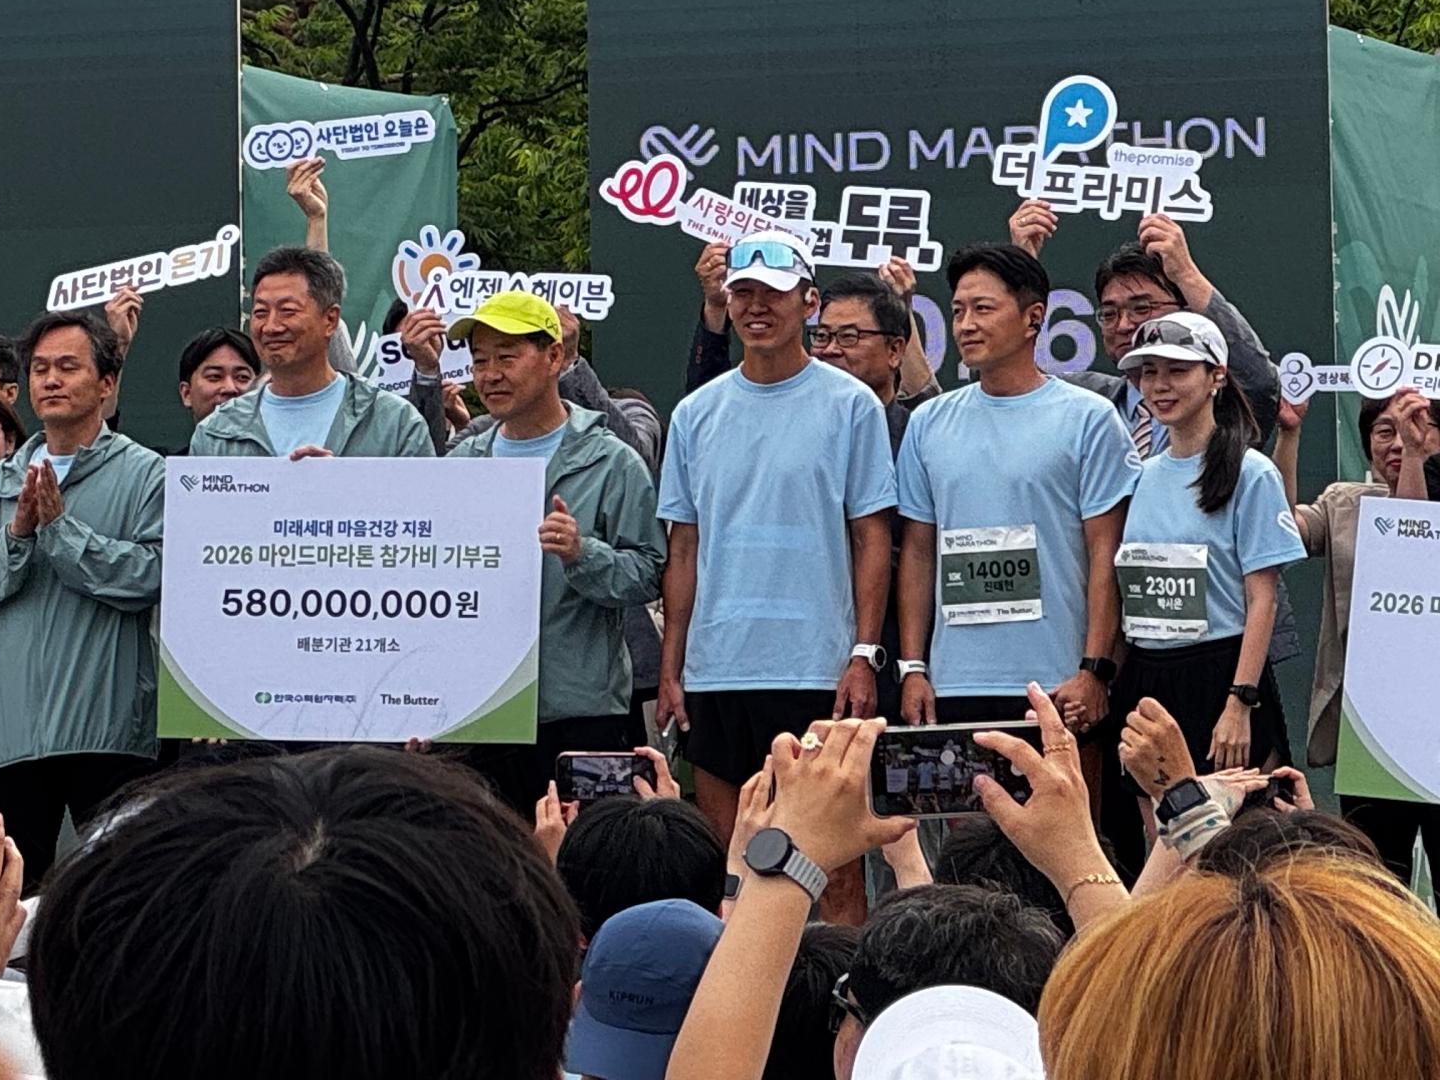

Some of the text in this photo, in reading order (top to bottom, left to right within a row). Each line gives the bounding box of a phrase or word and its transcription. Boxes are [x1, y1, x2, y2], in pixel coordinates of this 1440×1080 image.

[316, 117, 428, 146] 사단법인 오늘은
[737, 116, 1265, 176] MIND MAHON
[1113, 148, 1195, 168] thepromise
[687, 219, 705, 233] THE
[706, 226, 733, 244] SNAIL
[53, 257, 163, 307] 사단법인
[1317, 372, 1353, 385] 경상북
[202, 475, 233, 484] MIND
[202, 483, 270, 493] MARATHON
[273, 519, 433, 538] 미래세대 마음건강 지원
[1398, 518, 1432, 530] MIND
[202, 544, 502, 569] 2026 마인드마라톤 참가비 기부금
[967, 558, 1031, 580] 14009
[1145, 575, 1196, 597] 23011
[221, 587, 480, 621] 580,000,000원
[1370, 591, 1425, 616] 2026
[297, 637, 401, 653] 배분기관 21개소
[380, 694, 440, 706] The Butter
